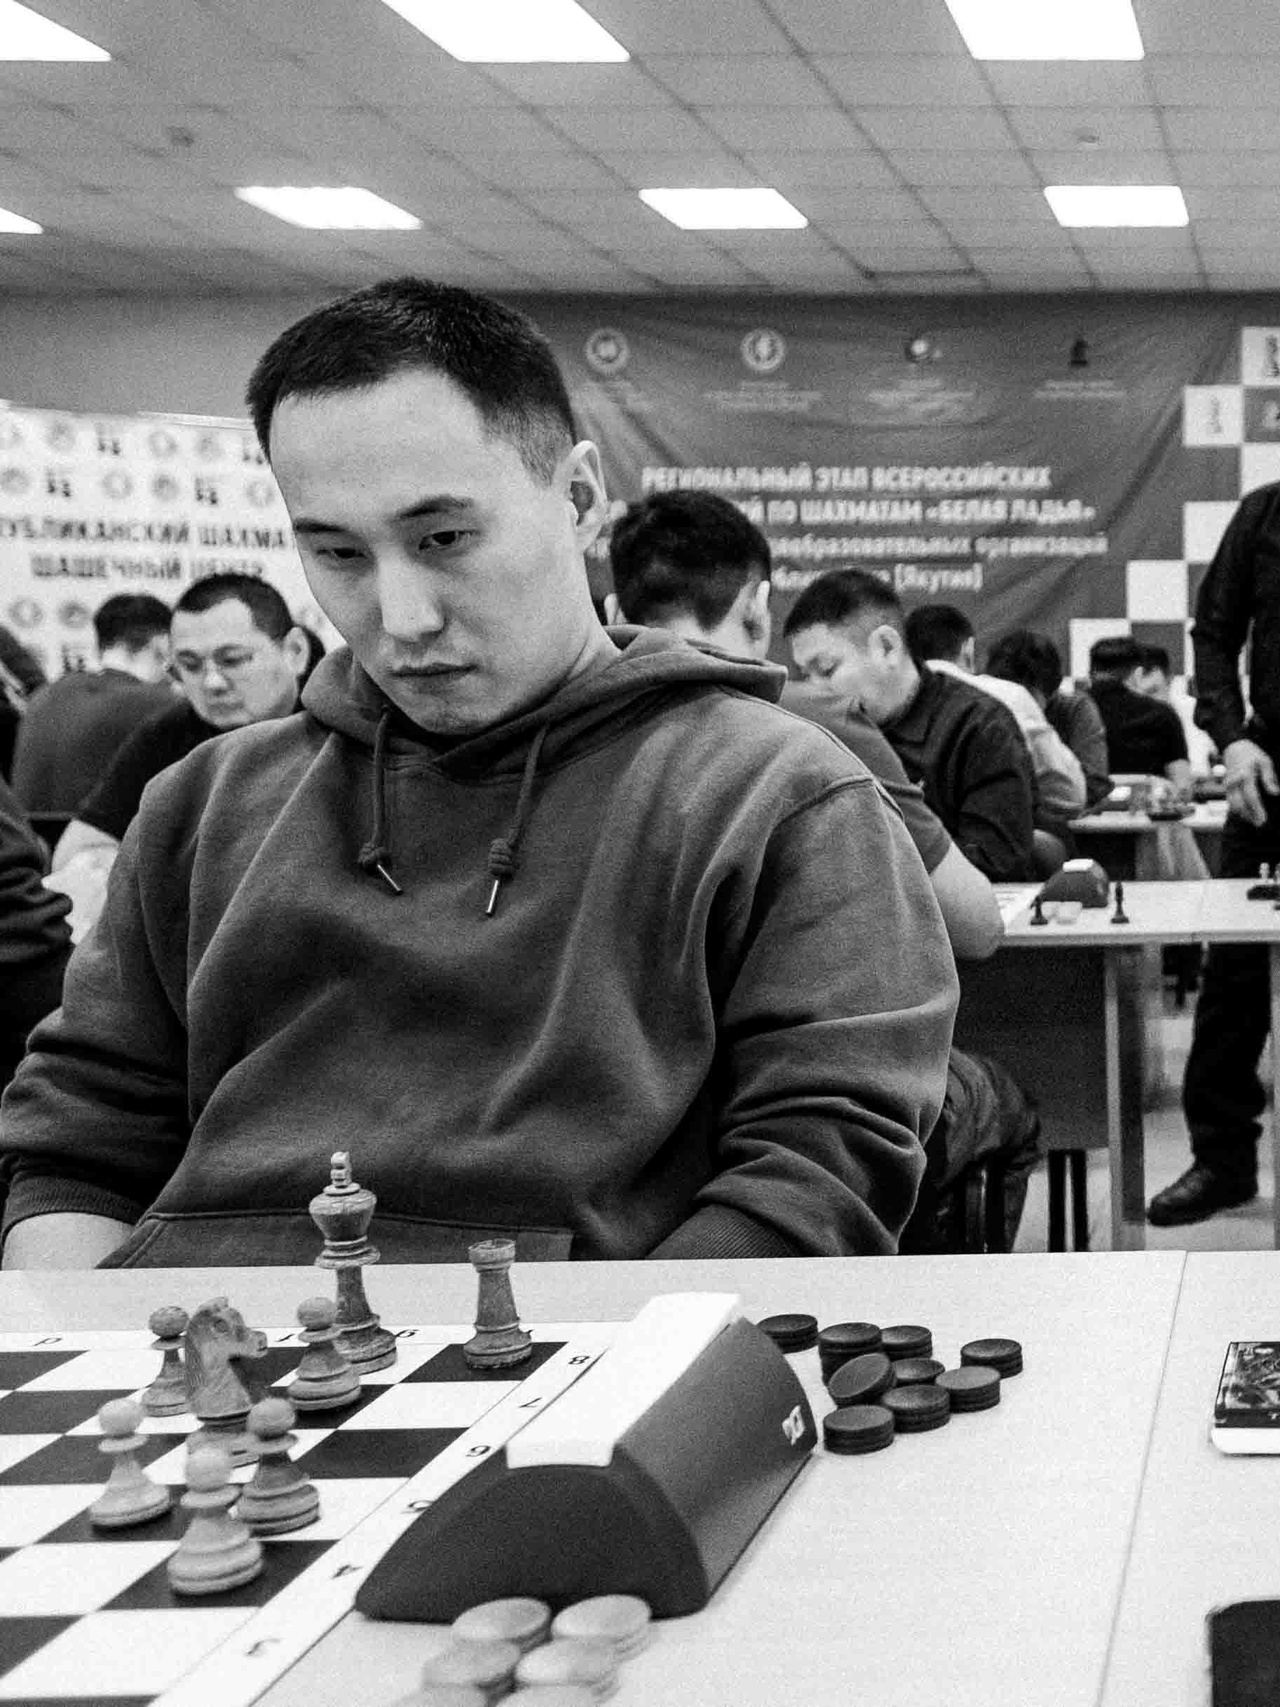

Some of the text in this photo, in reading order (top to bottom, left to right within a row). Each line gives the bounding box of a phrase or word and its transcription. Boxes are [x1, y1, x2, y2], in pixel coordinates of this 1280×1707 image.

[816, 466, 870, 491] ЭТАП
[872, 463, 1051, 491] ВСЕРОССИЙСКИХ
[766, 499, 798, 525] ПО
[801, 499, 923, 525] ШАХМАТАМ
